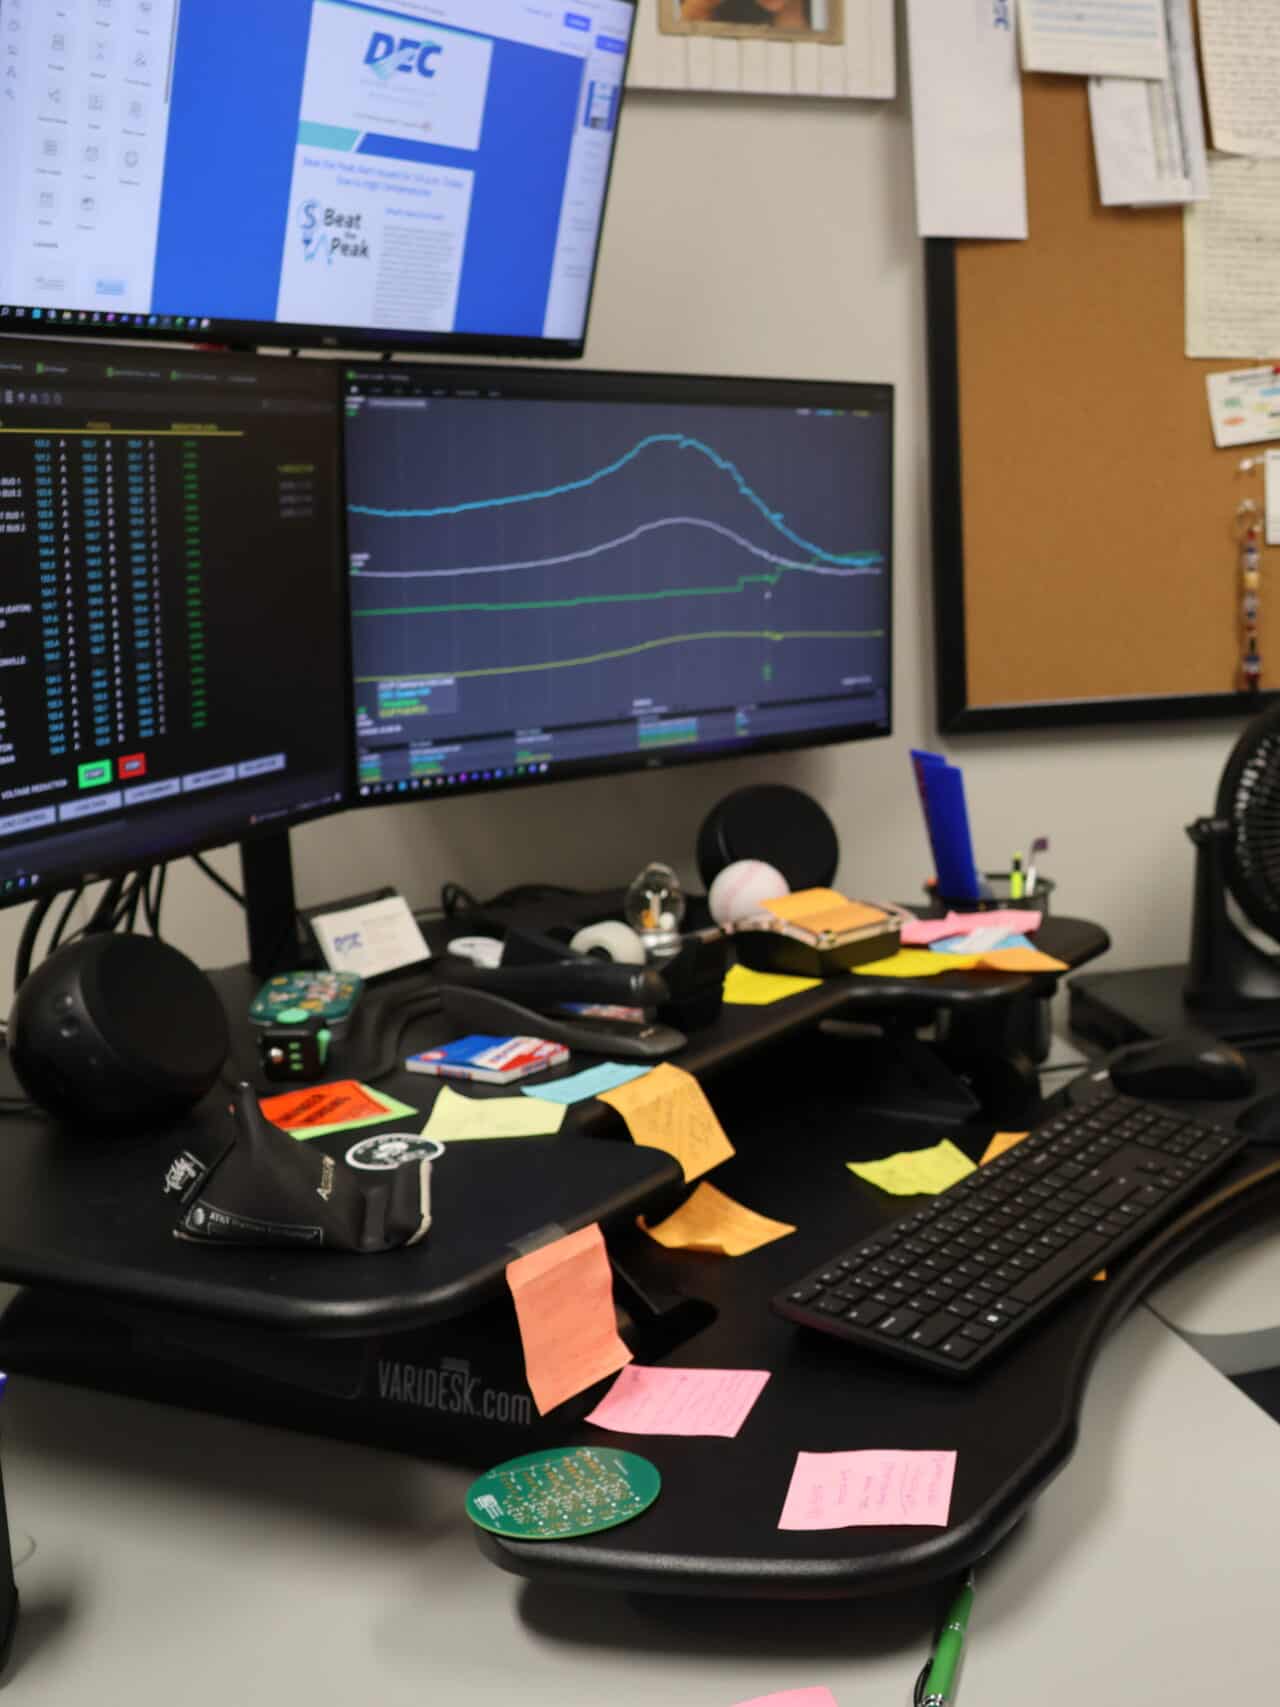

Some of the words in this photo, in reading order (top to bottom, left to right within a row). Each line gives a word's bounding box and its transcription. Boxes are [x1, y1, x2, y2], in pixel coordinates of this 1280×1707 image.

[364, 31, 443, 79] DEC
[324, 207, 362, 230] Beat
[330, 236, 370, 259] Peak
